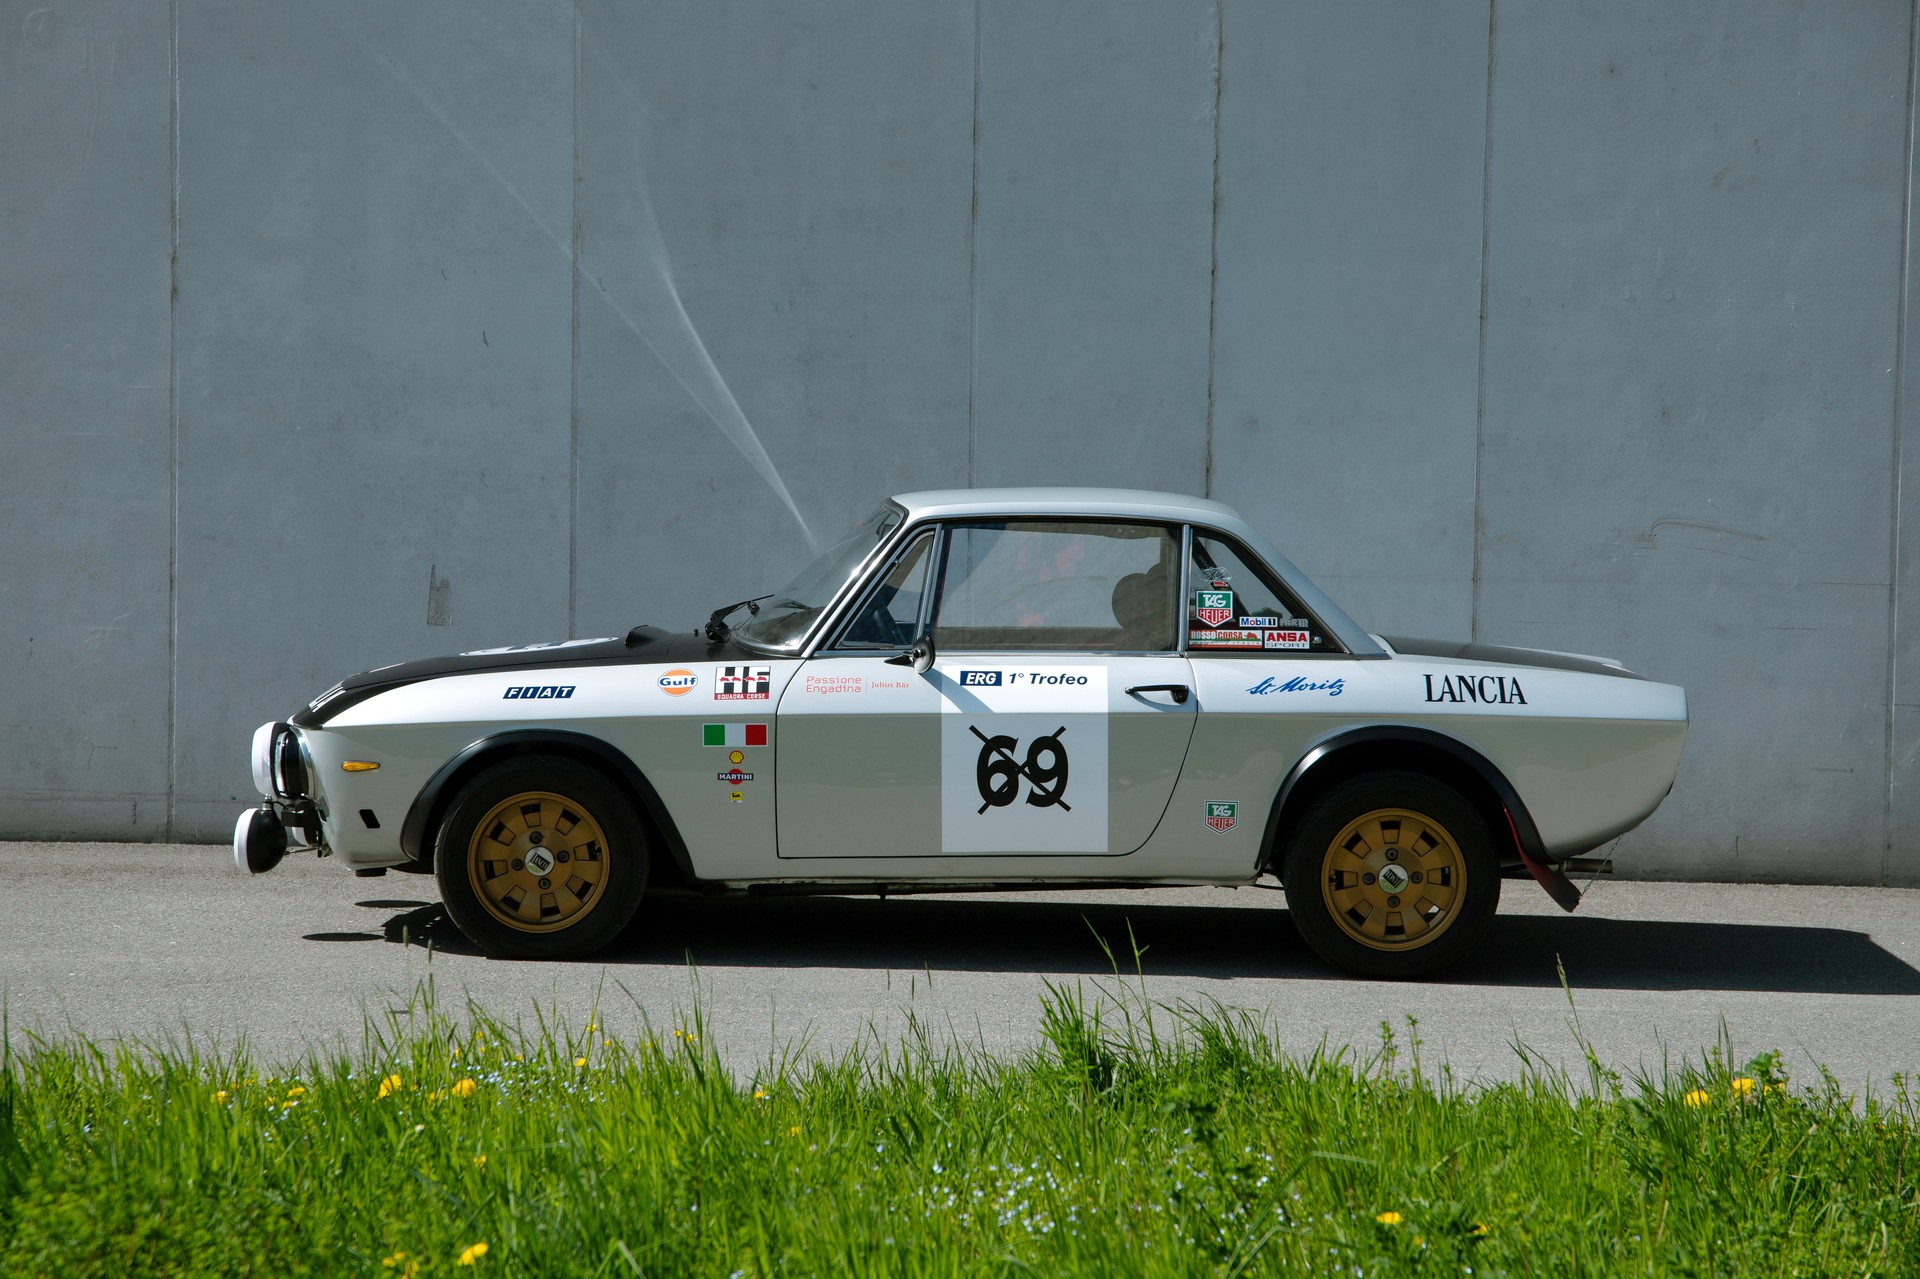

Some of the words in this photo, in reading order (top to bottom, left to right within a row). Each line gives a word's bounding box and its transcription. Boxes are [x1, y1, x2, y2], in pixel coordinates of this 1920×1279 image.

[1202, 593, 1227, 607] TAG
[1199, 609, 1230, 624] HEUER
[1241, 617, 1267, 626] Mobil
[1190, 631, 1216, 639] ROSSO
[1217, 631, 1243, 639] CORSA
[1266, 632, 1308, 642] ANSA
[659, 677, 697, 686] Gulf
[806, 675, 862, 684] Passione
[965, 672, 997, 685] ERG
[1009, 672, 1025, 684] 1°
[1030, 673, 1088, 685] Trofeo
[806, 684, 862, 694] Engadina
[871, 681, 894, 689] Julius
[1270, 676, 1346, 697] Moritz
[1423, 674, 1528, 705] LANCIA
[506, 686, 574, 699] FIAT
[976, 734, 1069, 808] 69
[1211, 804, 1232, 816] TAG
[1208, 817, 1234, 830] HEUER
